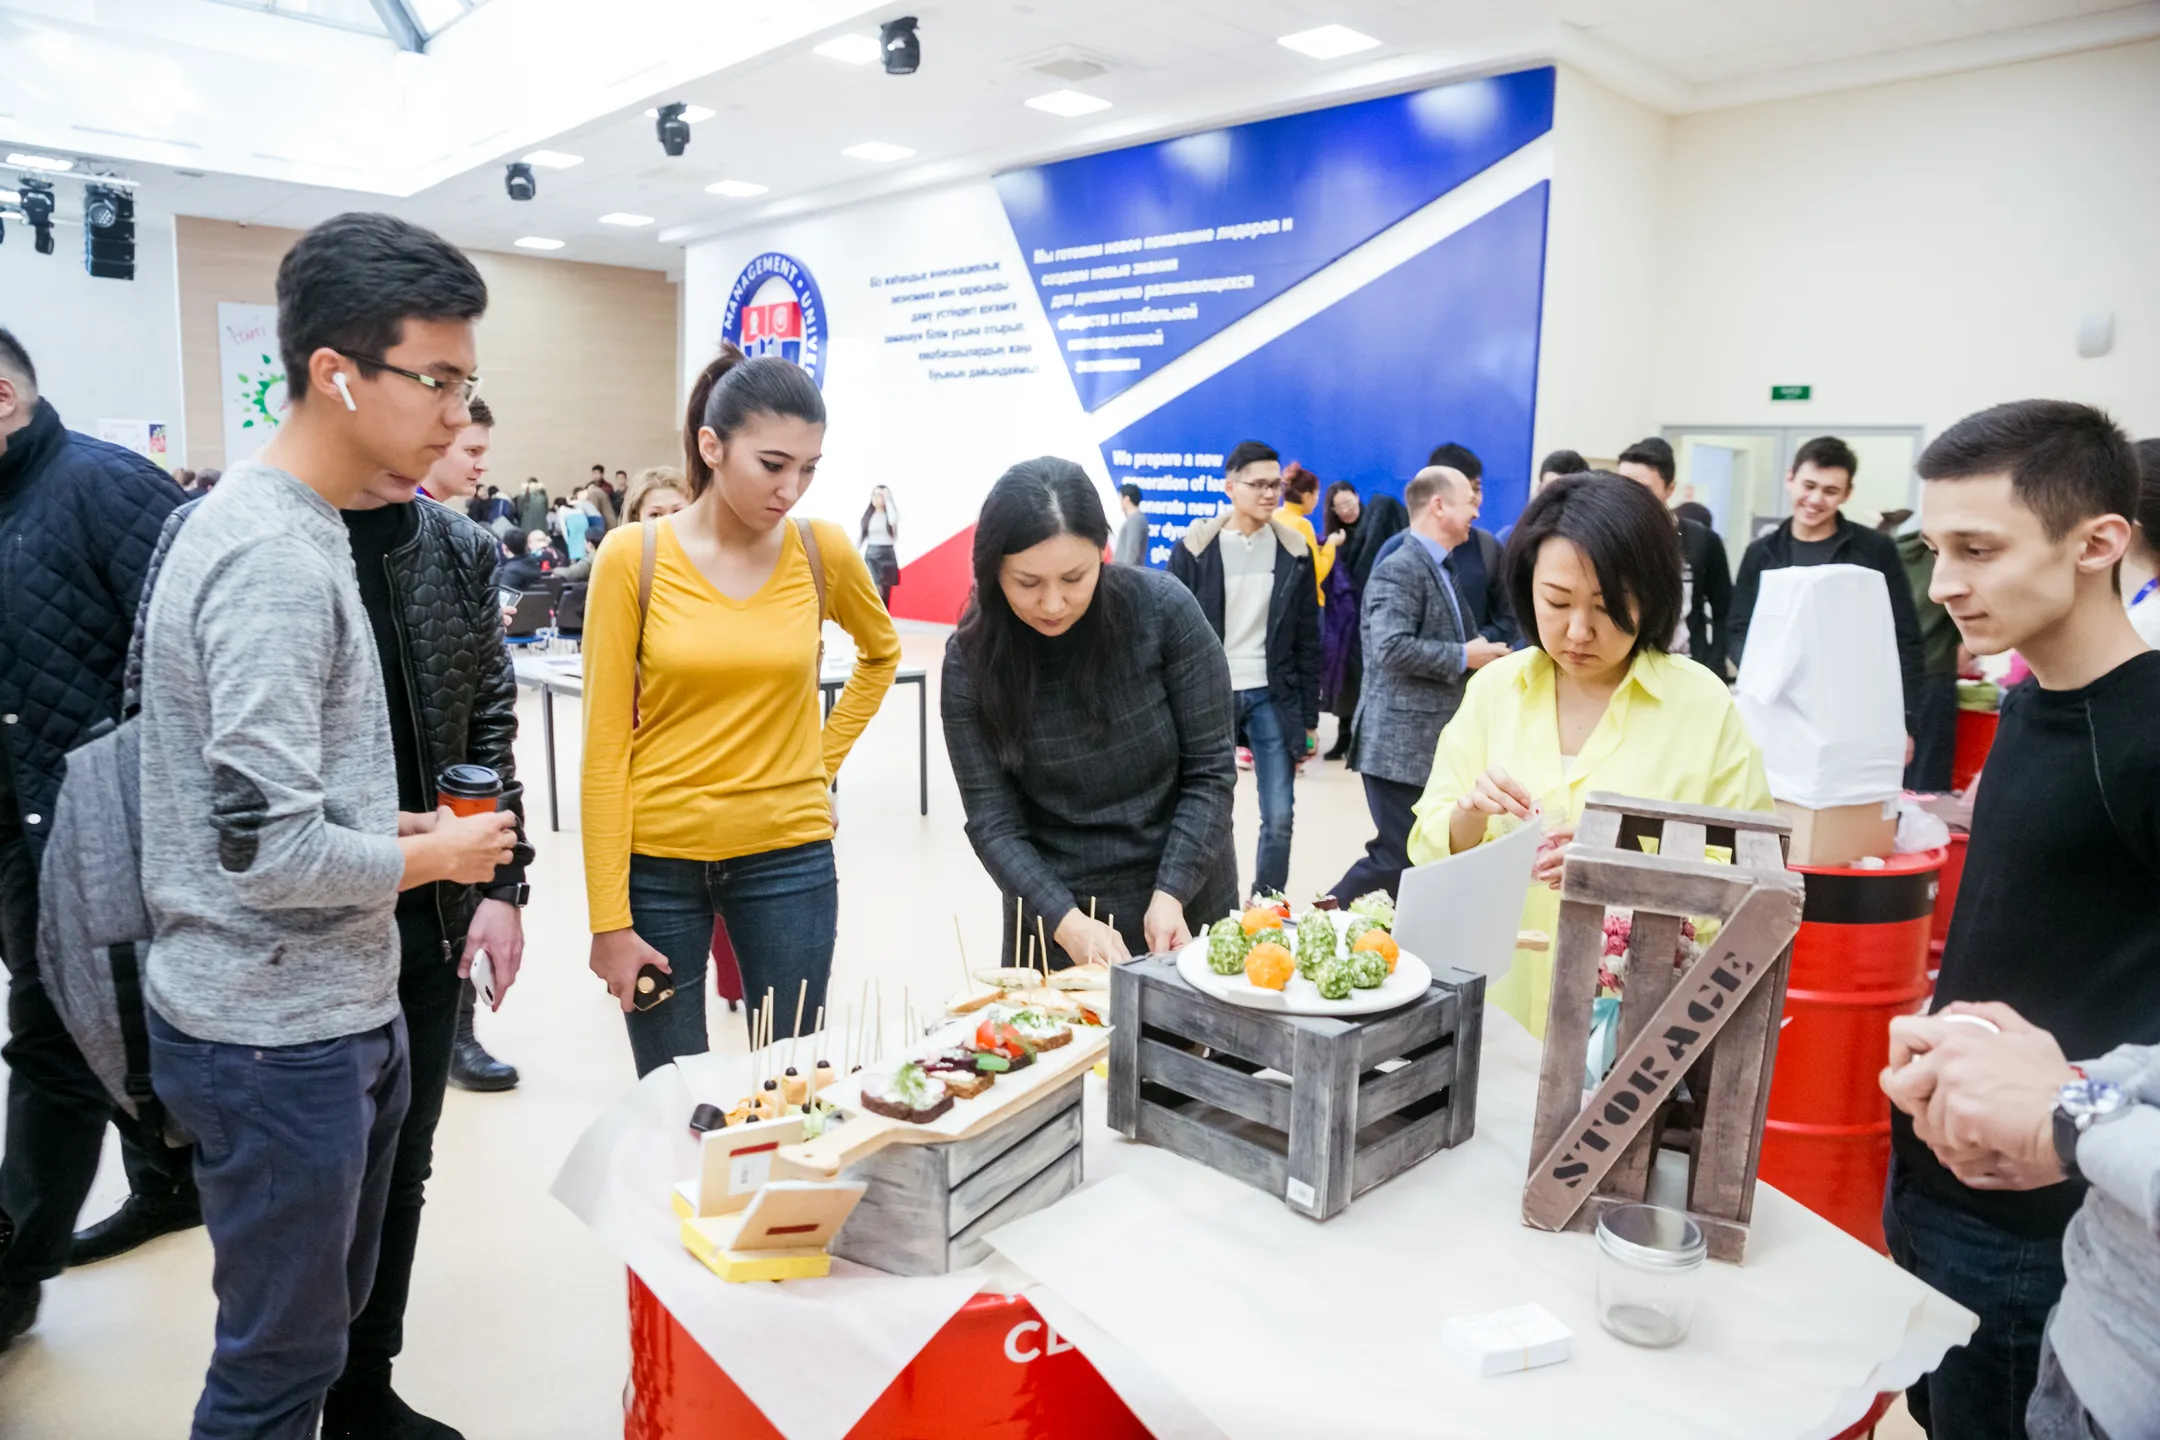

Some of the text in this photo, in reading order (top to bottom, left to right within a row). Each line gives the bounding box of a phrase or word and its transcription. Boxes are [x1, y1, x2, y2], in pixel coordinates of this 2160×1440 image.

[724, 255, 799, 331] MANAGEMENT
[1112, 450, 1224, 470] We prepare a new
[1189, 474, 1206, 492] of
[1187, 502, 1216, 516] new
[1553, 951, 1755, 1189] STORAGE
